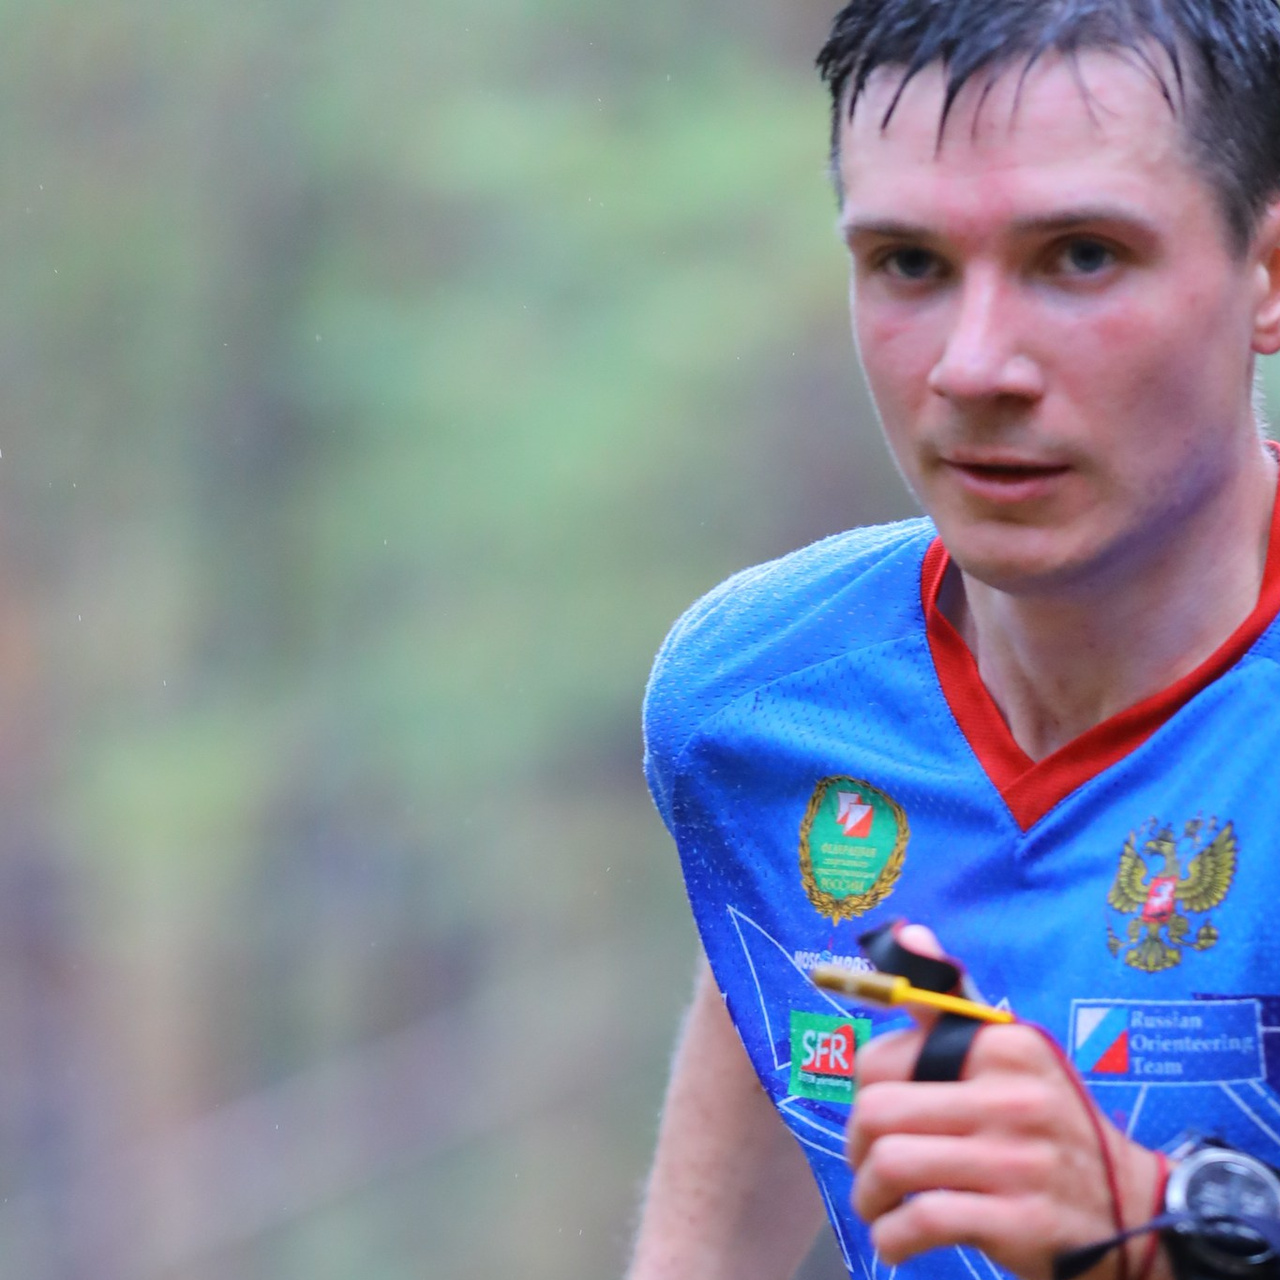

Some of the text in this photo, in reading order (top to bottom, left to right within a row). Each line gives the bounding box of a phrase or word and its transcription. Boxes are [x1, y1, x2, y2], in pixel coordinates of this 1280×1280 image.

[1130, 1010, 1203, 1028] Russian
[801, 1029, 849, 1070] SFR
[1130, 1033, 1255, 1054] Orienteering
[1131, 1056, 1184, 1075] Team
